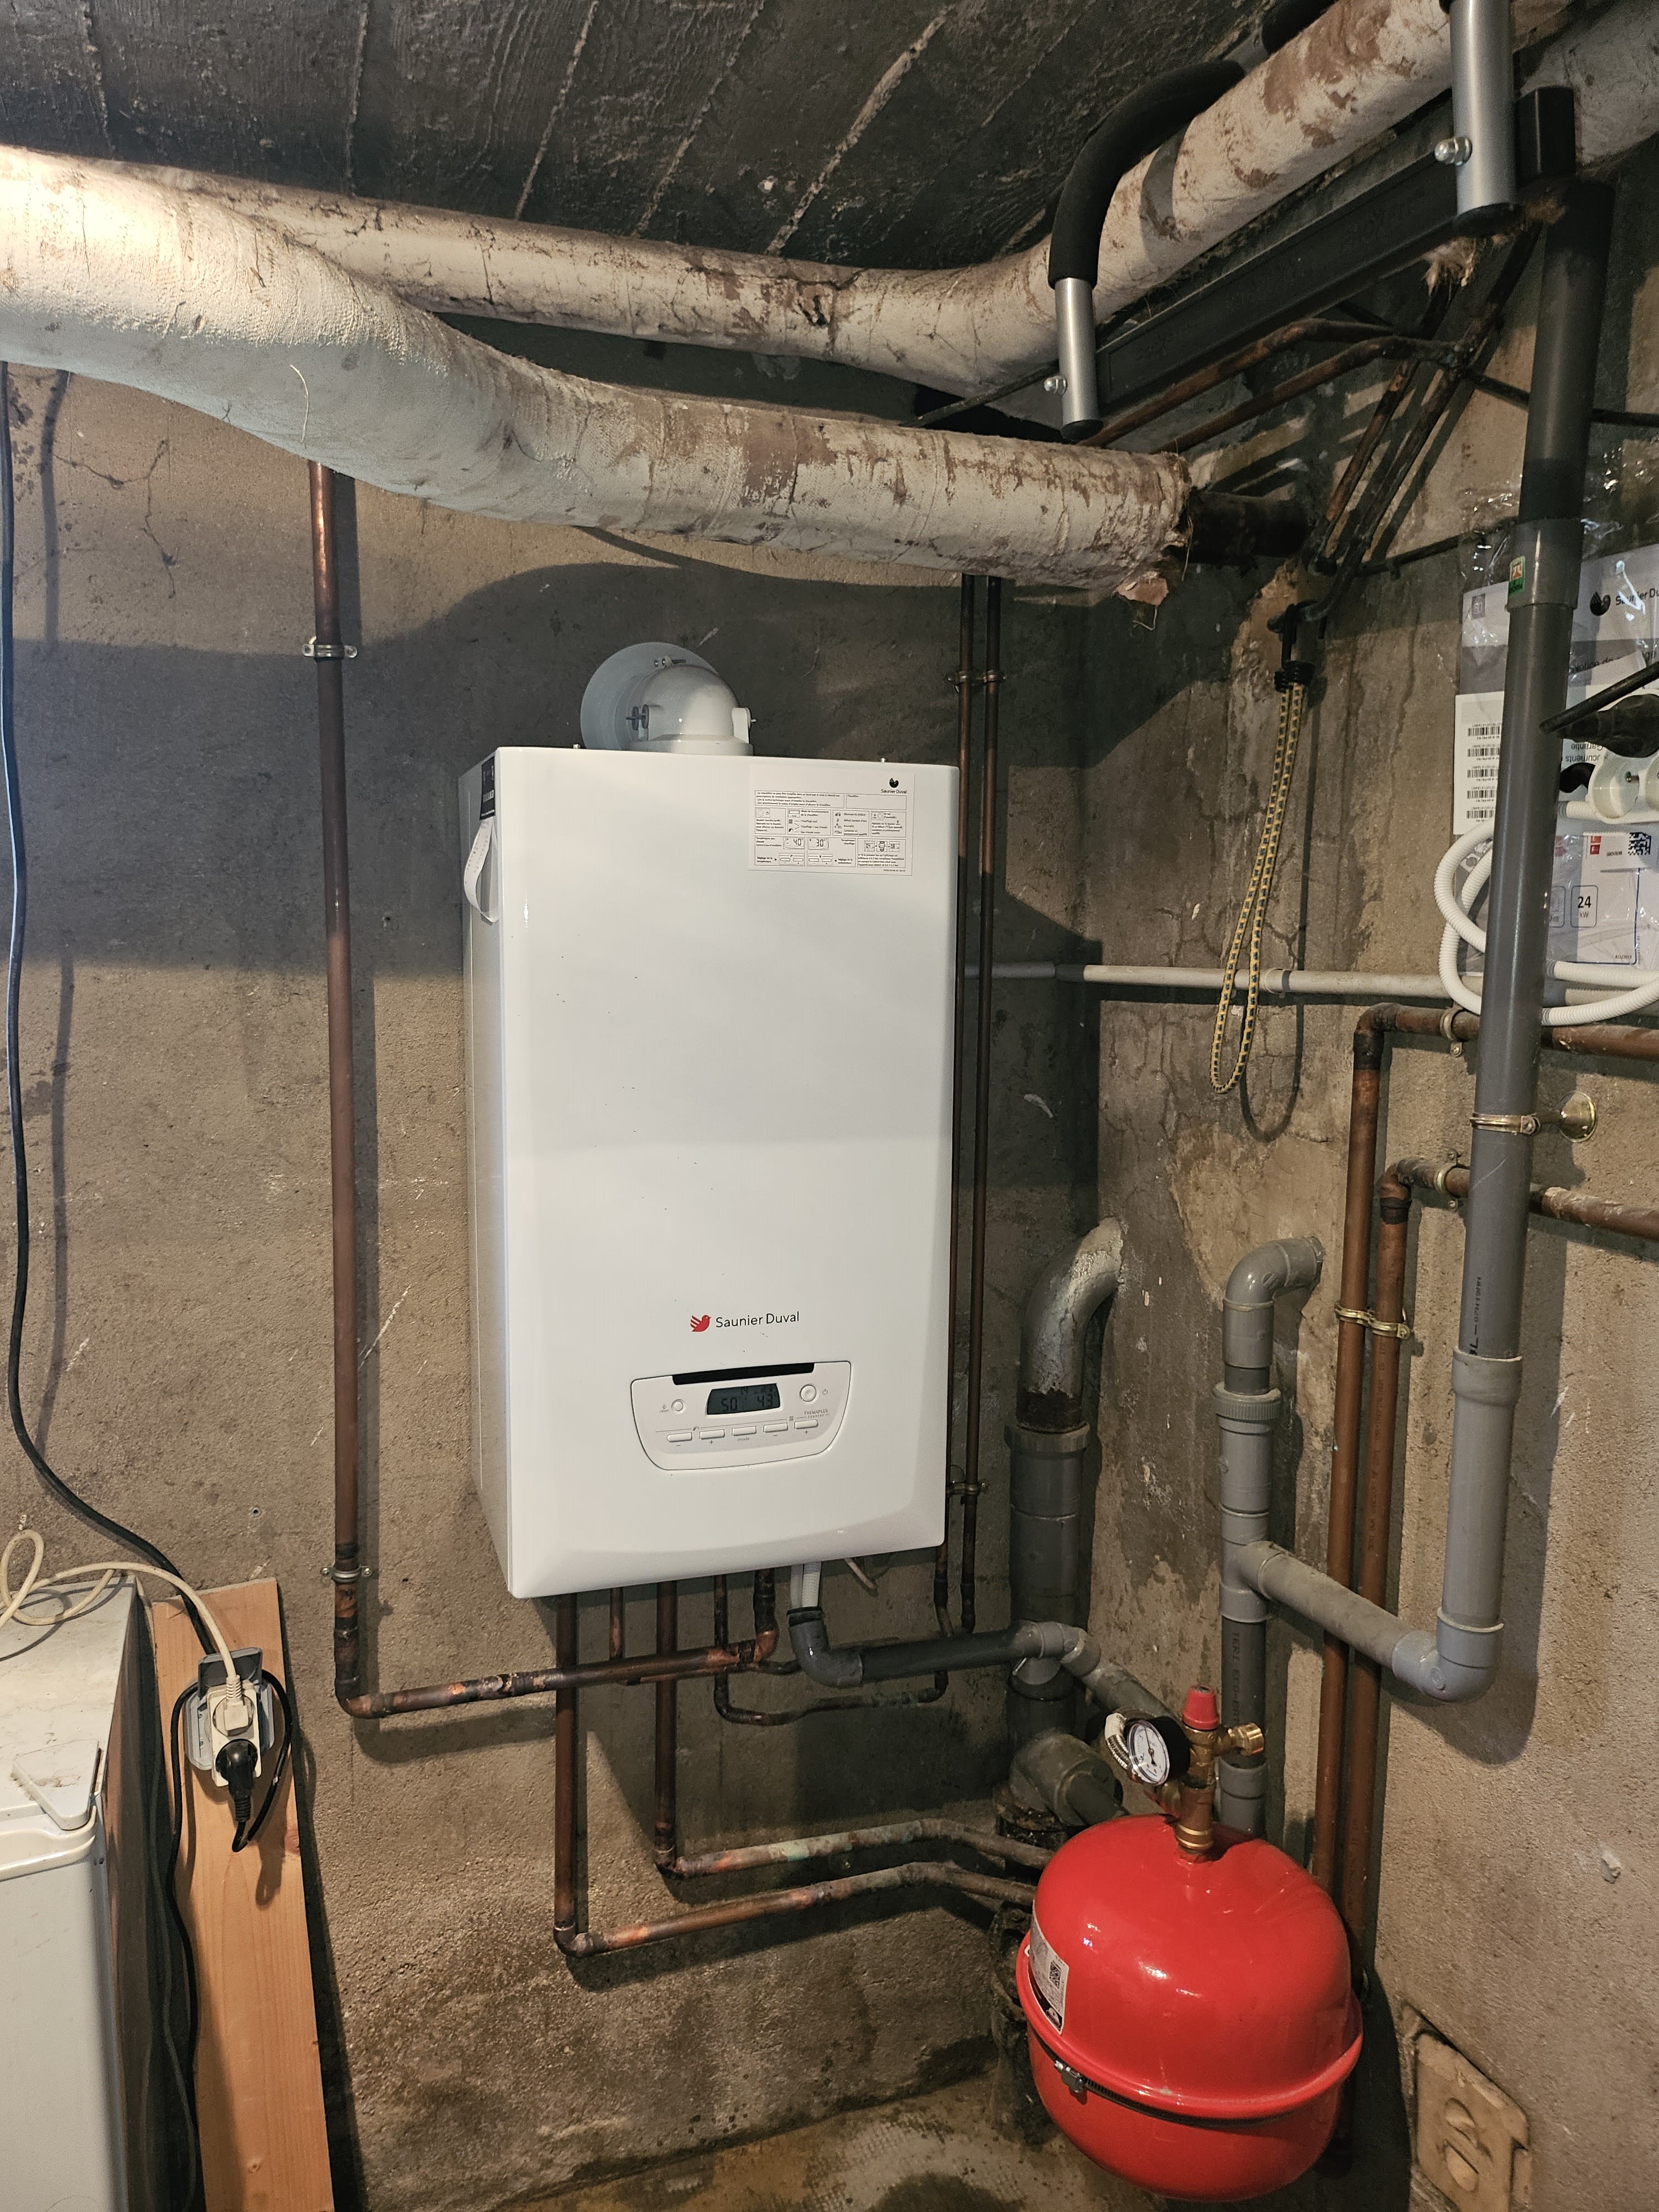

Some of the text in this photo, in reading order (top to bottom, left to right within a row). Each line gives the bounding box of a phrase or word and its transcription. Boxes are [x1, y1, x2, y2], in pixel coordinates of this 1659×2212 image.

[1577, 896, 1592, 909] 24
[716, 1311, 800, 1328] Saunier Duval
[757, 1394, 774, 1407] 43
